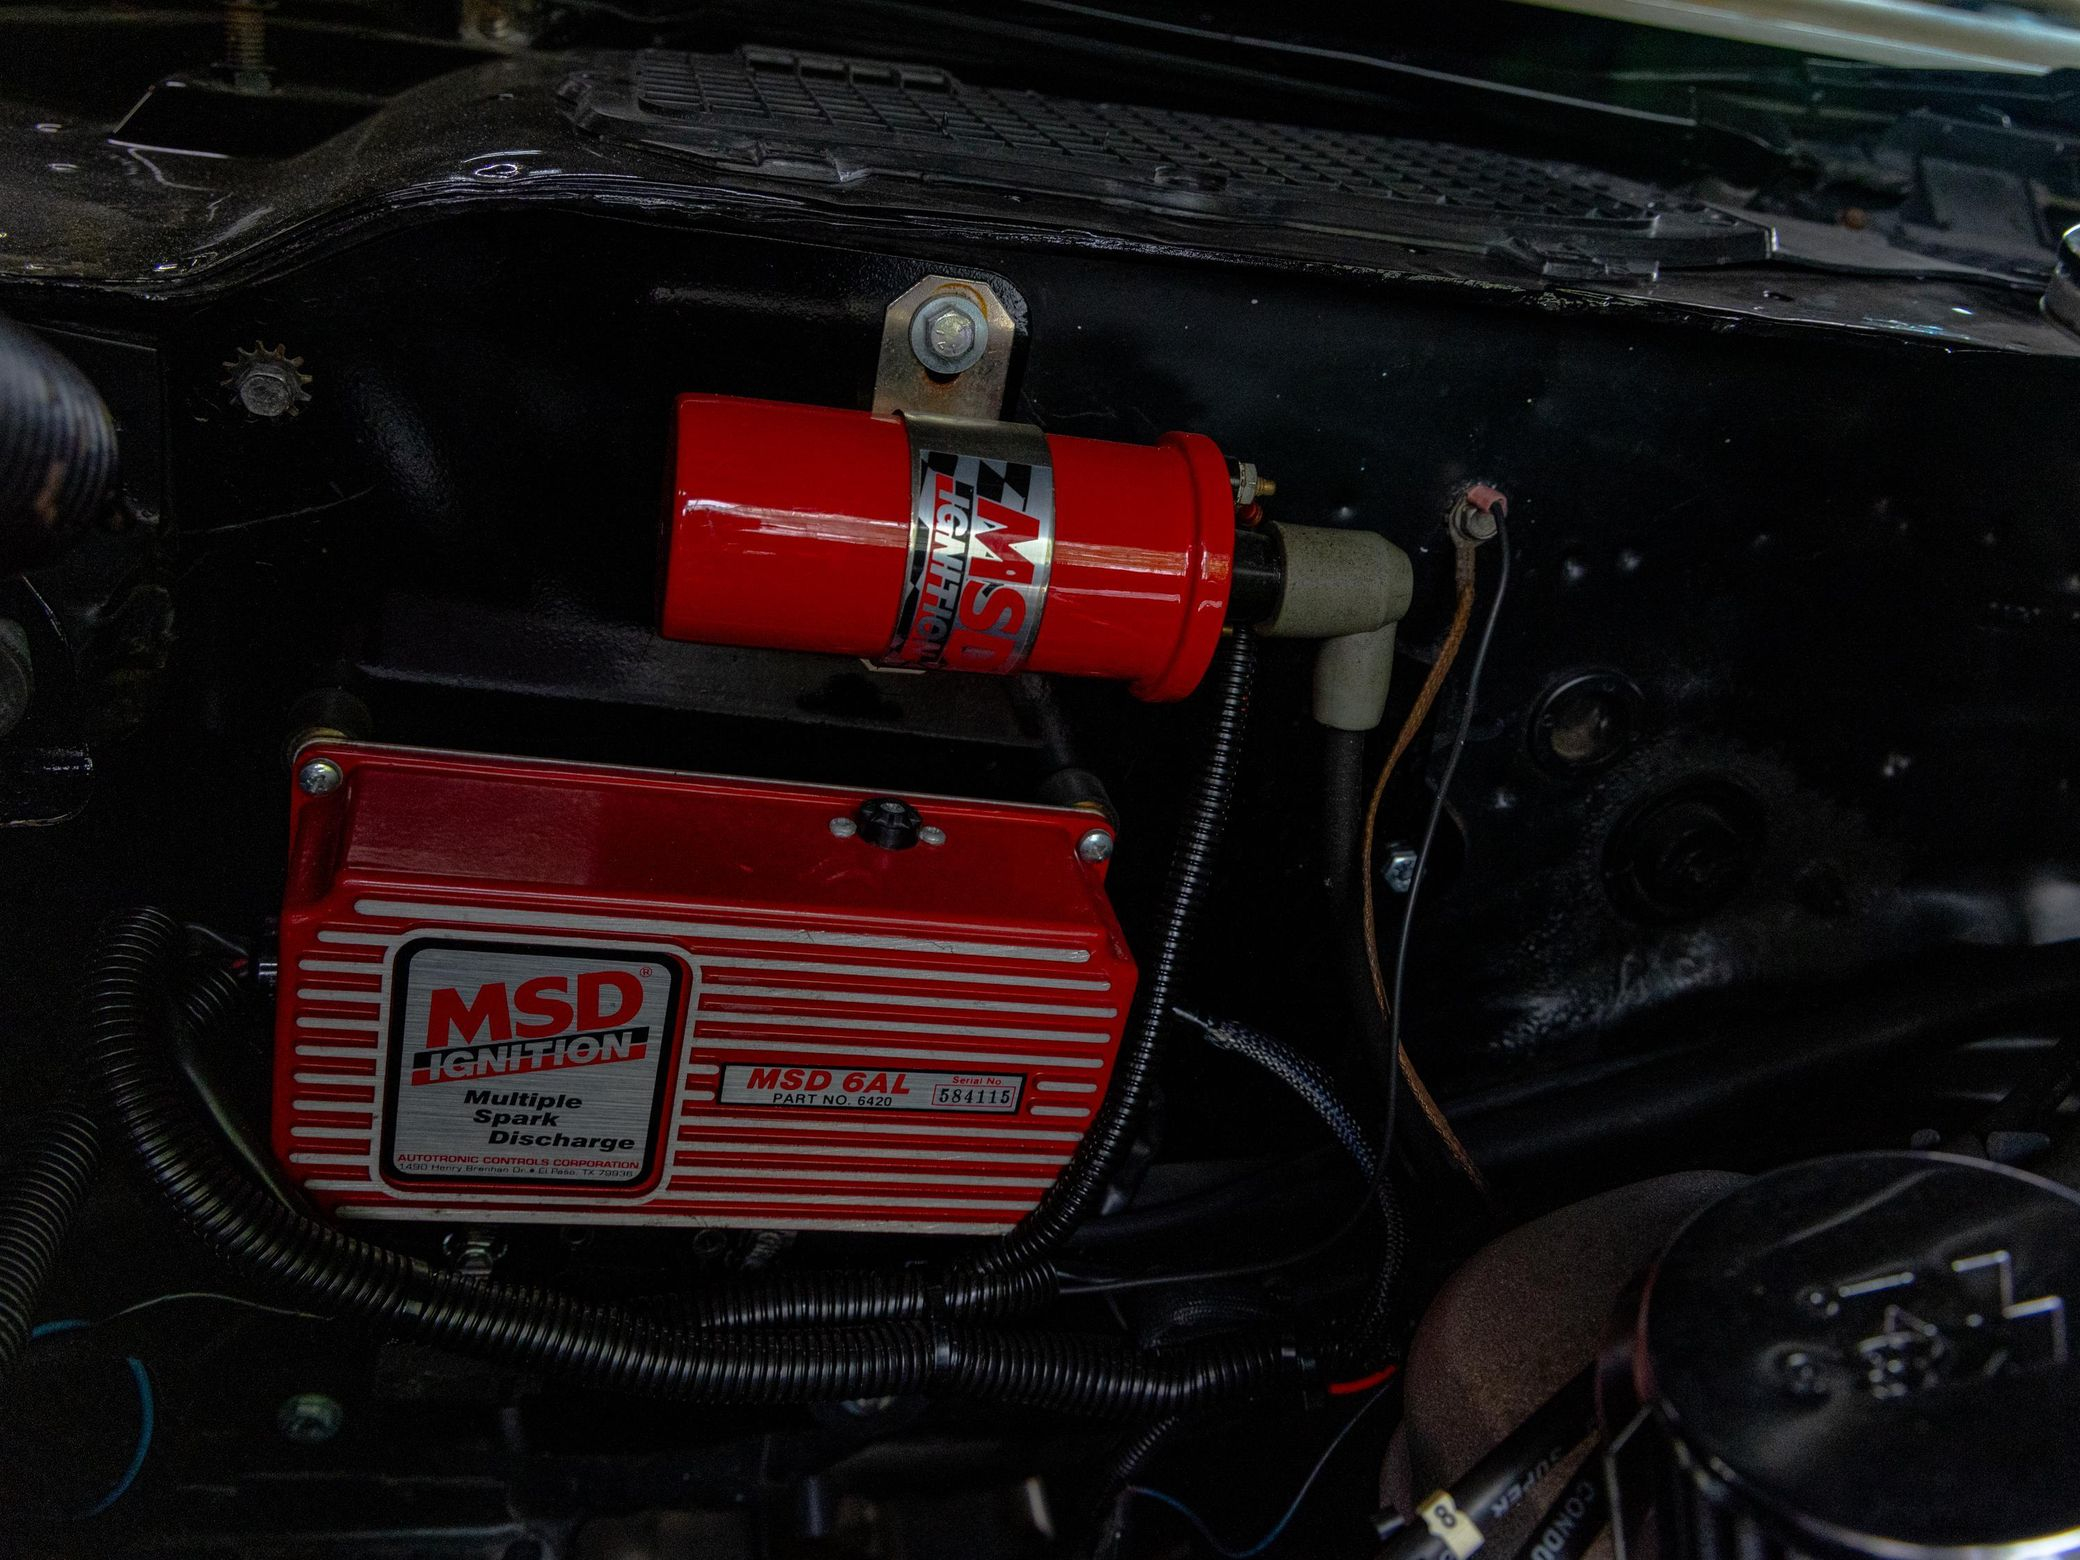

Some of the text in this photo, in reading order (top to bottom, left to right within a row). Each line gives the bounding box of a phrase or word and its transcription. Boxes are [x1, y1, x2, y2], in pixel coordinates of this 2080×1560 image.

[911, 487, 973, 665] IGNITION
[946, 496, 1041, 674] MSD
[426, 970, 644, 1049] MSD
[429, 1031, 633, 1081] IGNITION
[746, 1067, 911, 1096] MSD 6AL
[952, 1075, 983, 1086] Serial
[463, 1090, 583, 1112] Multiple
[772, 1092, 893, 1107] PART NO. 6420
[938, 1087, 1012, 1105] 584115
[472, 1108, 560, 1129] Spark
[488, 1129, 636, 1153] Discharge
[398, 1153, 639, 1169] AUTOTRONIC CONTROLS CORPORATION
[431, 1163, 463, 1173] Henry
[583, 1168, 595, 1176] TX
[1434, 1504, 1456, 1528] 8
